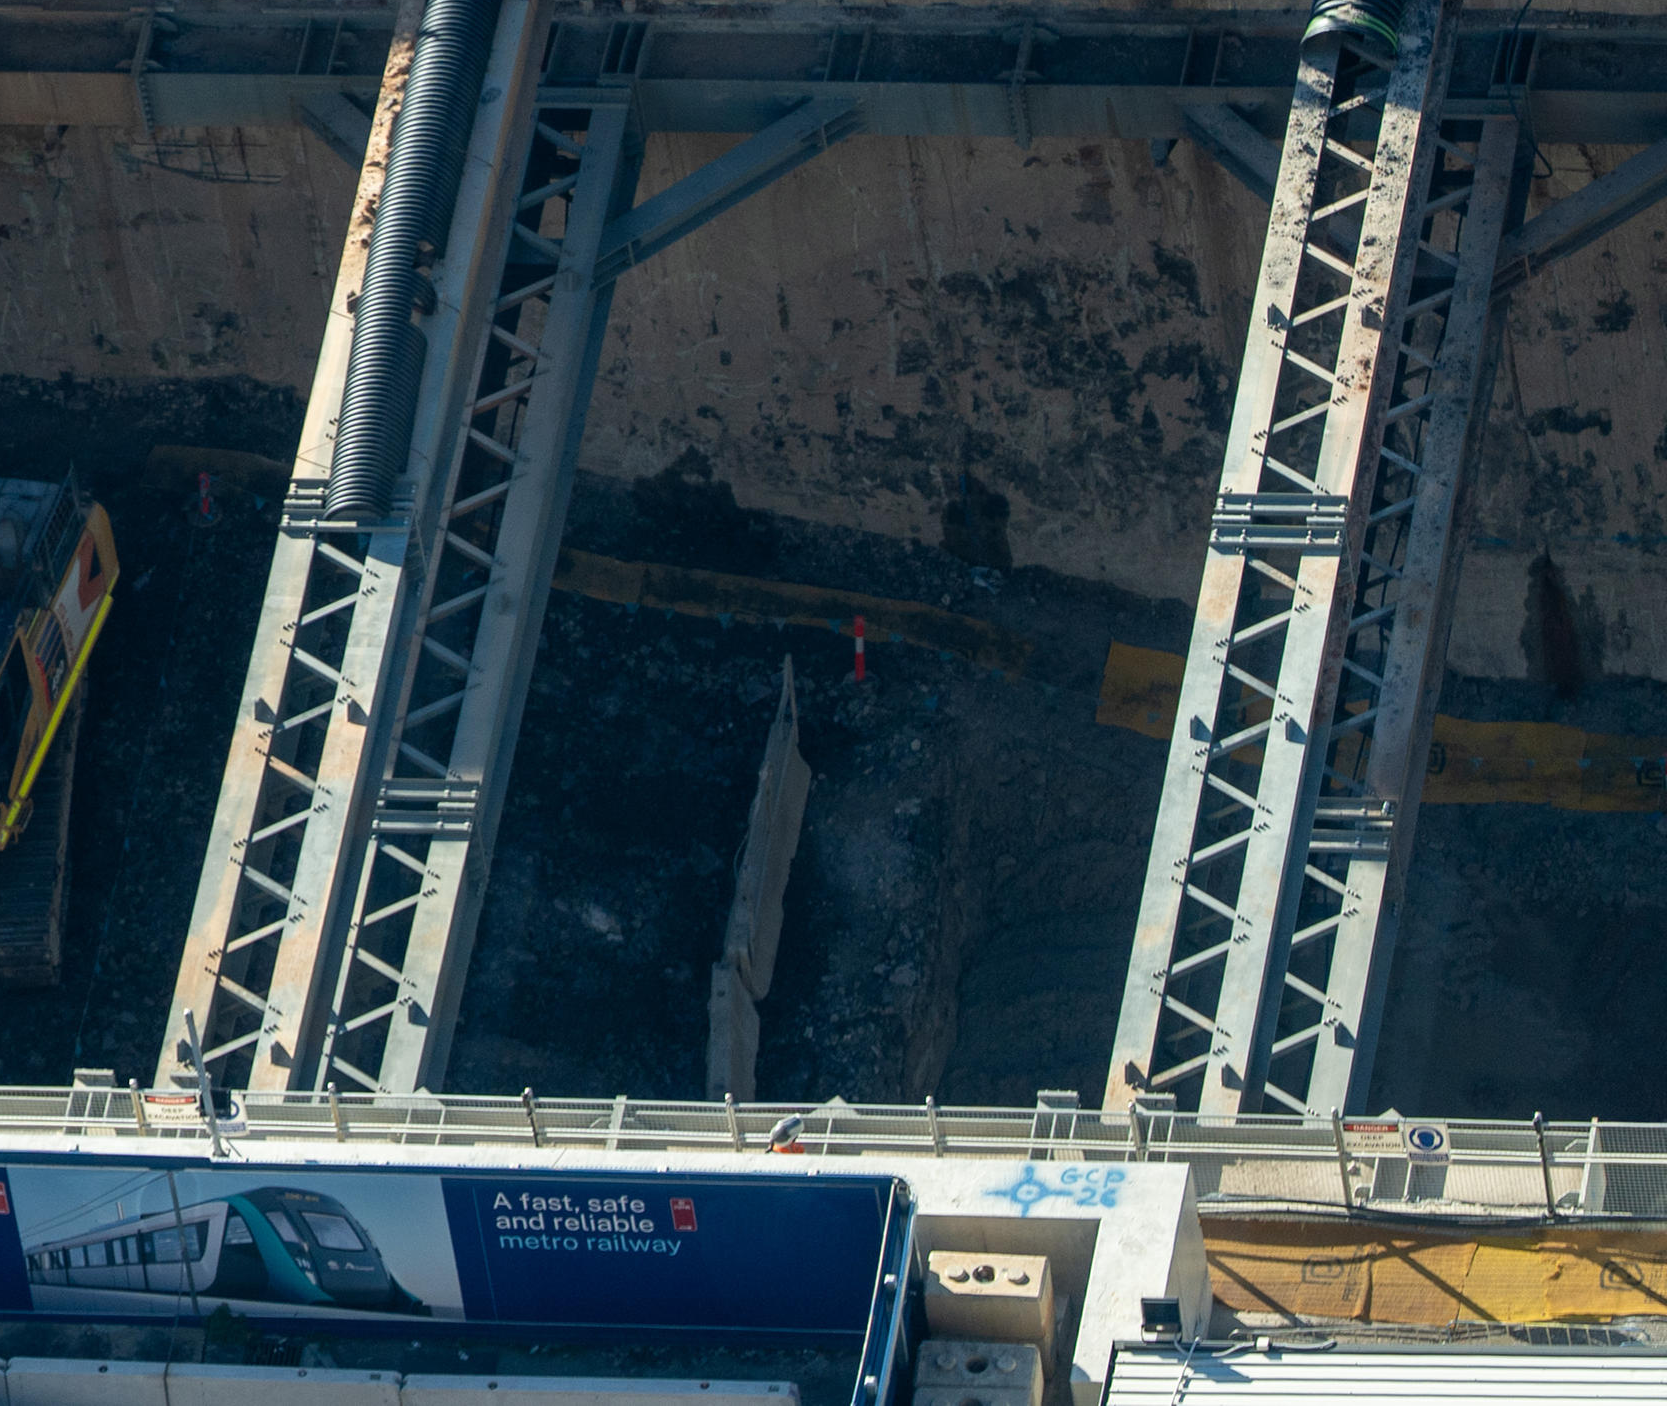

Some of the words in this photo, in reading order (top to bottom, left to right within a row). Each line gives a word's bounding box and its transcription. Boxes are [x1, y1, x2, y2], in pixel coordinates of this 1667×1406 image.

[1353, 1124, 1388, 1132] DANGER
[1060, 1167, 1126, 1189] GCP
[493, 1192, 513, 1211] A
[519, 1192, 580, 1214] fast,
[587, 1195, 646, 1213] safe
[496, 1212, 545, 1231] and
[553, 1213, 655, 1234] reliable
[499, 1233, 579, 1251] metro
[587, 1234, 682, 1257] railway
